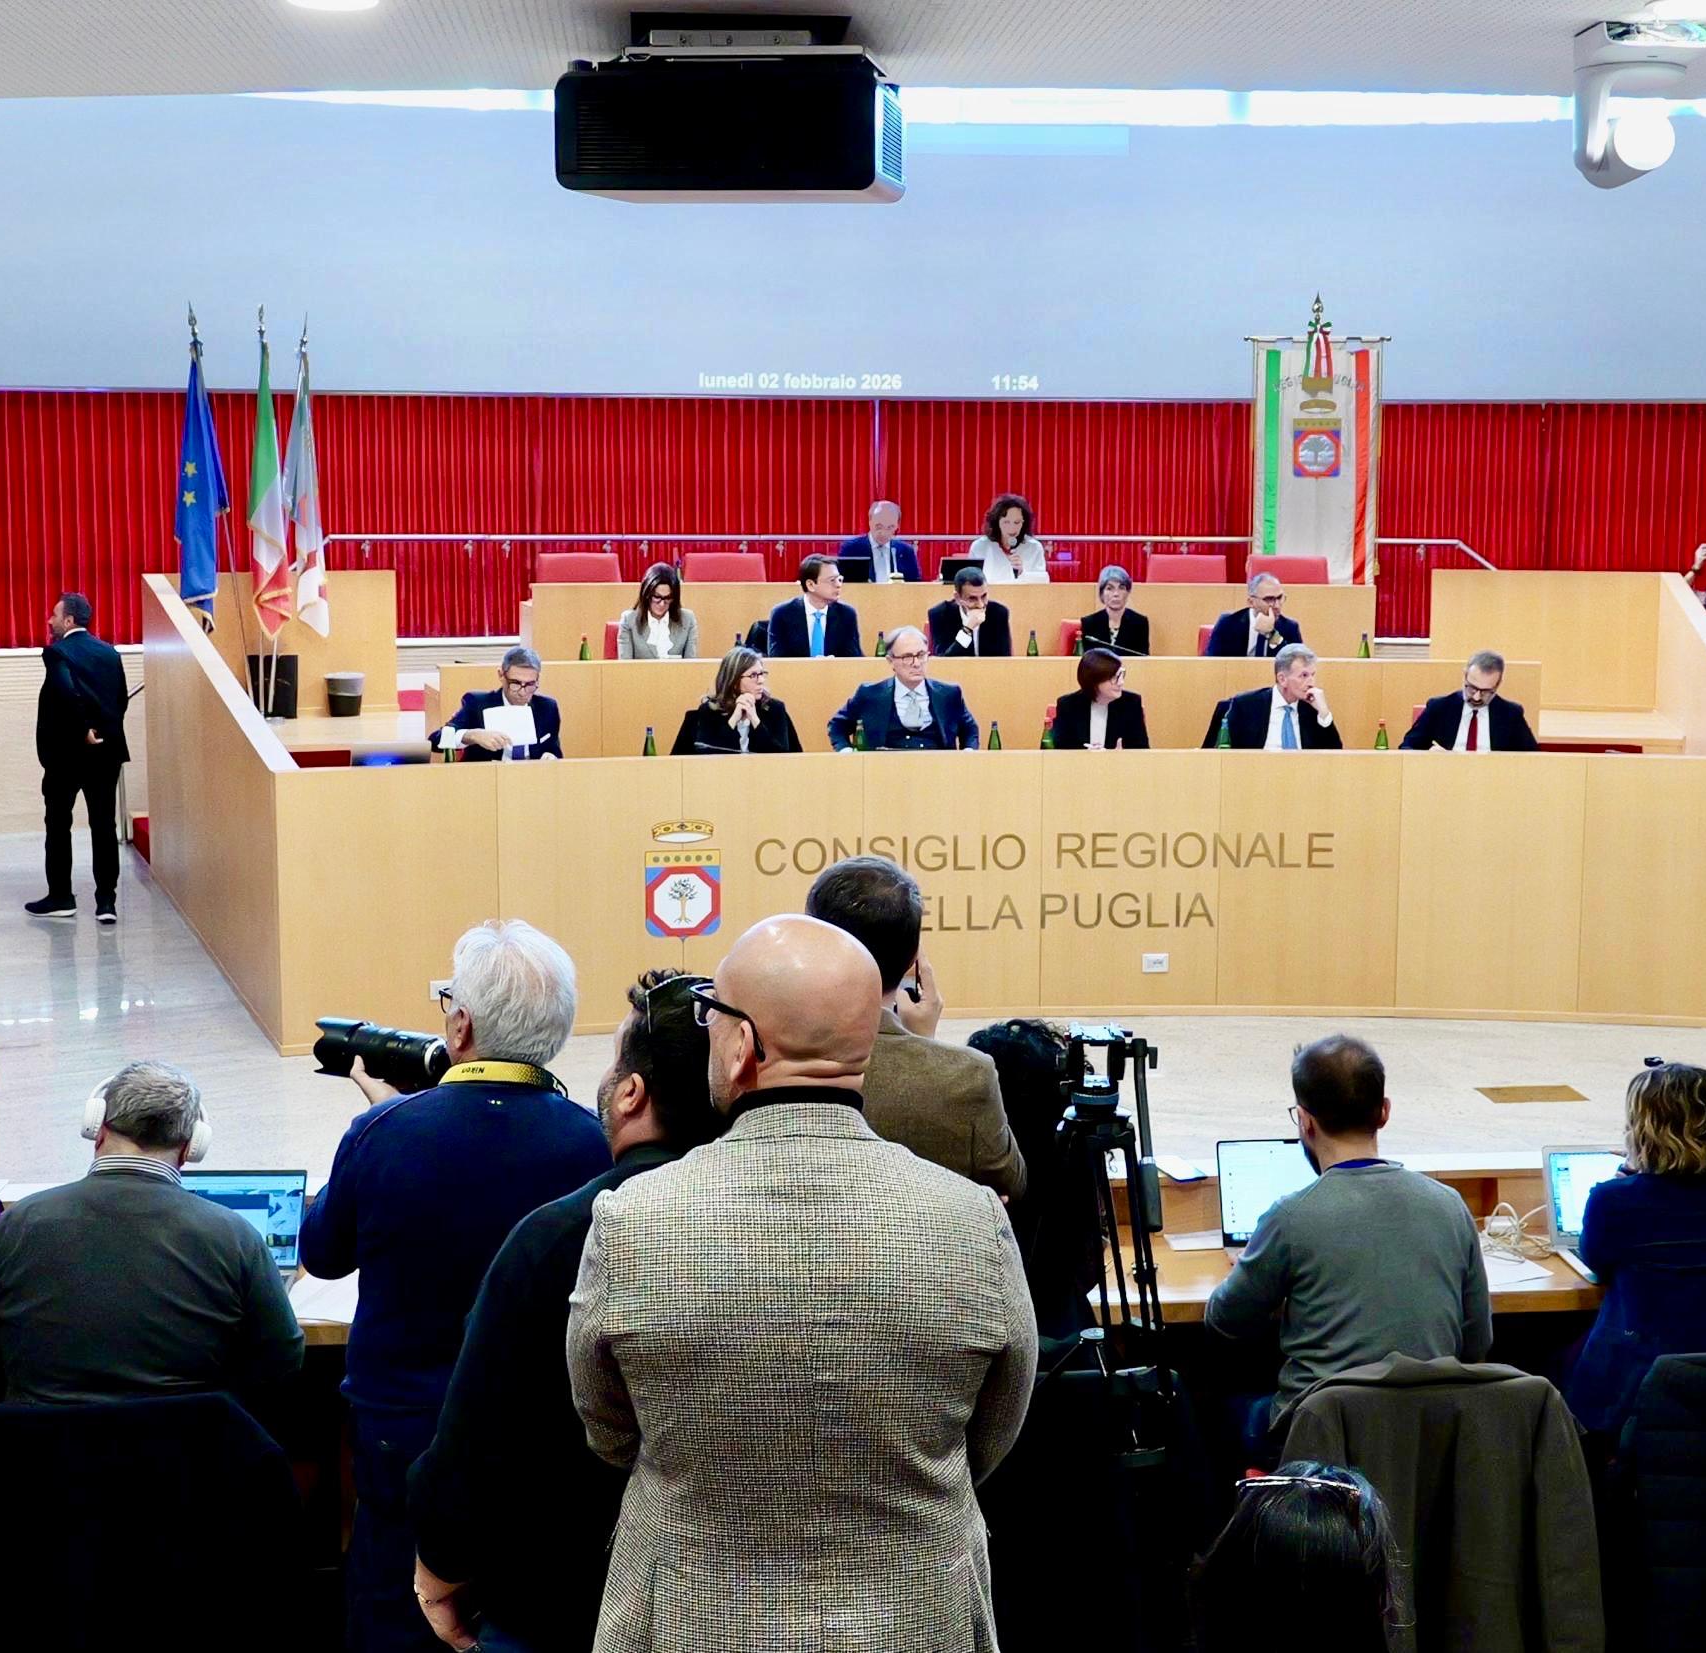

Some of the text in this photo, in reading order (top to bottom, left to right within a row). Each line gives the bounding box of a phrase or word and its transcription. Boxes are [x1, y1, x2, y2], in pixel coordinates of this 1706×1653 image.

[758, 372, 780, 390] 02
[784, 372, 857, 390] febbraio
[860, 373, 903, 391] 2026
[990, 374, 1040, 391] 11:54
[754, 832, 1335, 876] CONSIGLIO REGIONALE
[1039, 892, 1215, 930] PUGLIA
